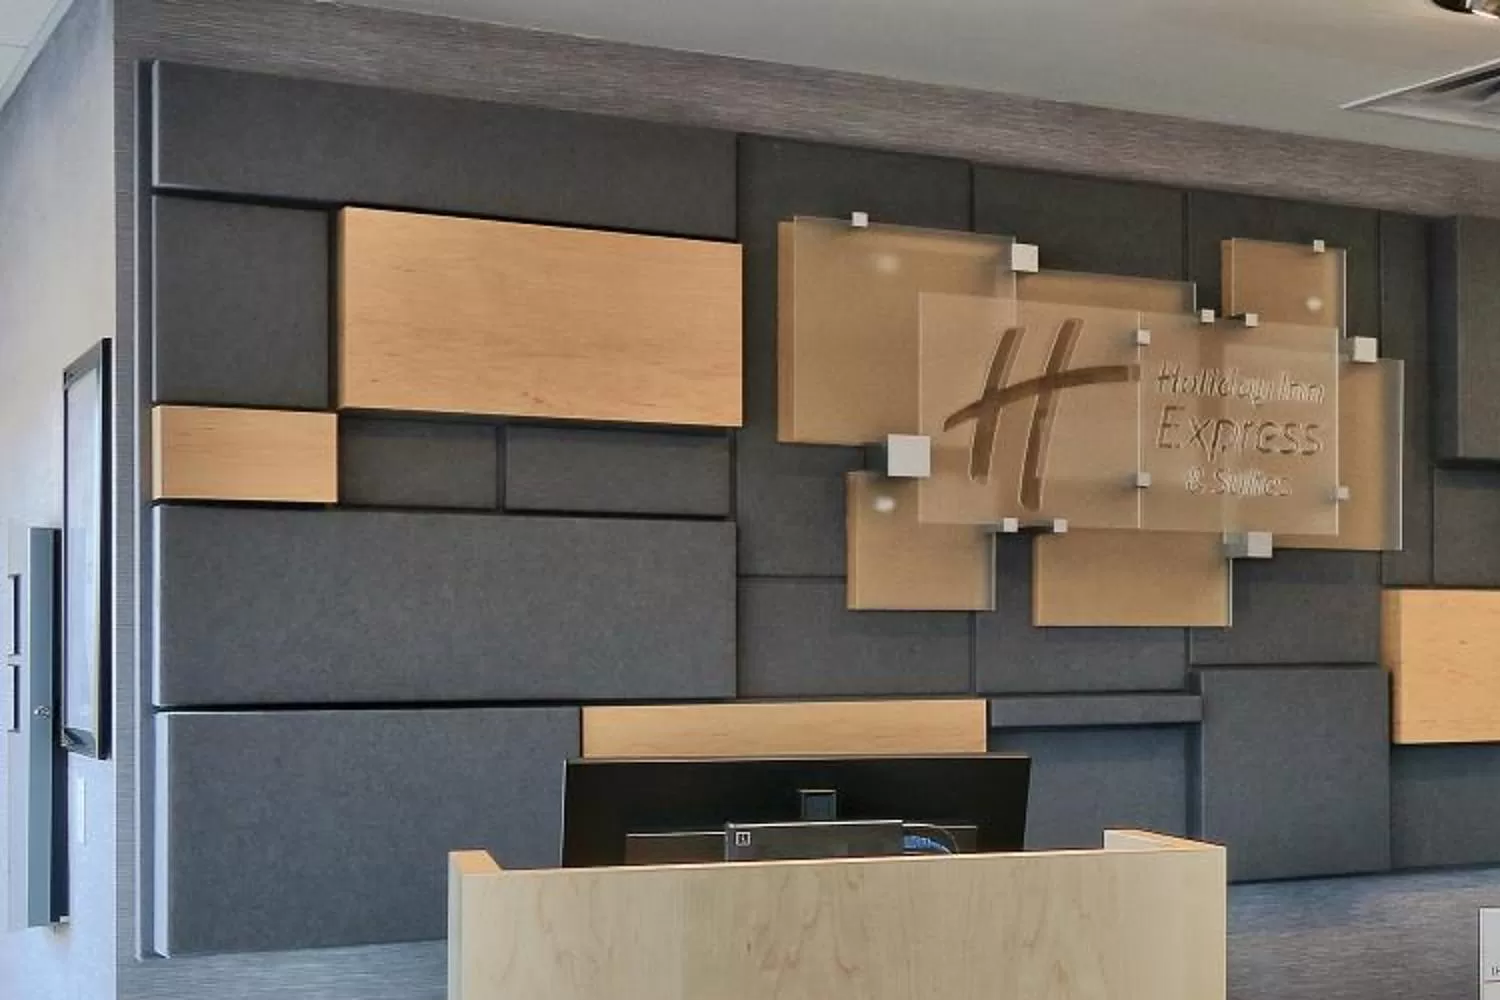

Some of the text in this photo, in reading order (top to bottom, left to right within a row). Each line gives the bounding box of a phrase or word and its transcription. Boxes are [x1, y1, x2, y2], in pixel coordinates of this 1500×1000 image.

[1156, 360, 1326, 407] Holiday Inn
[1156, 404, 1324, 462] Express
[1211, 467, 1293, 497] Suites
